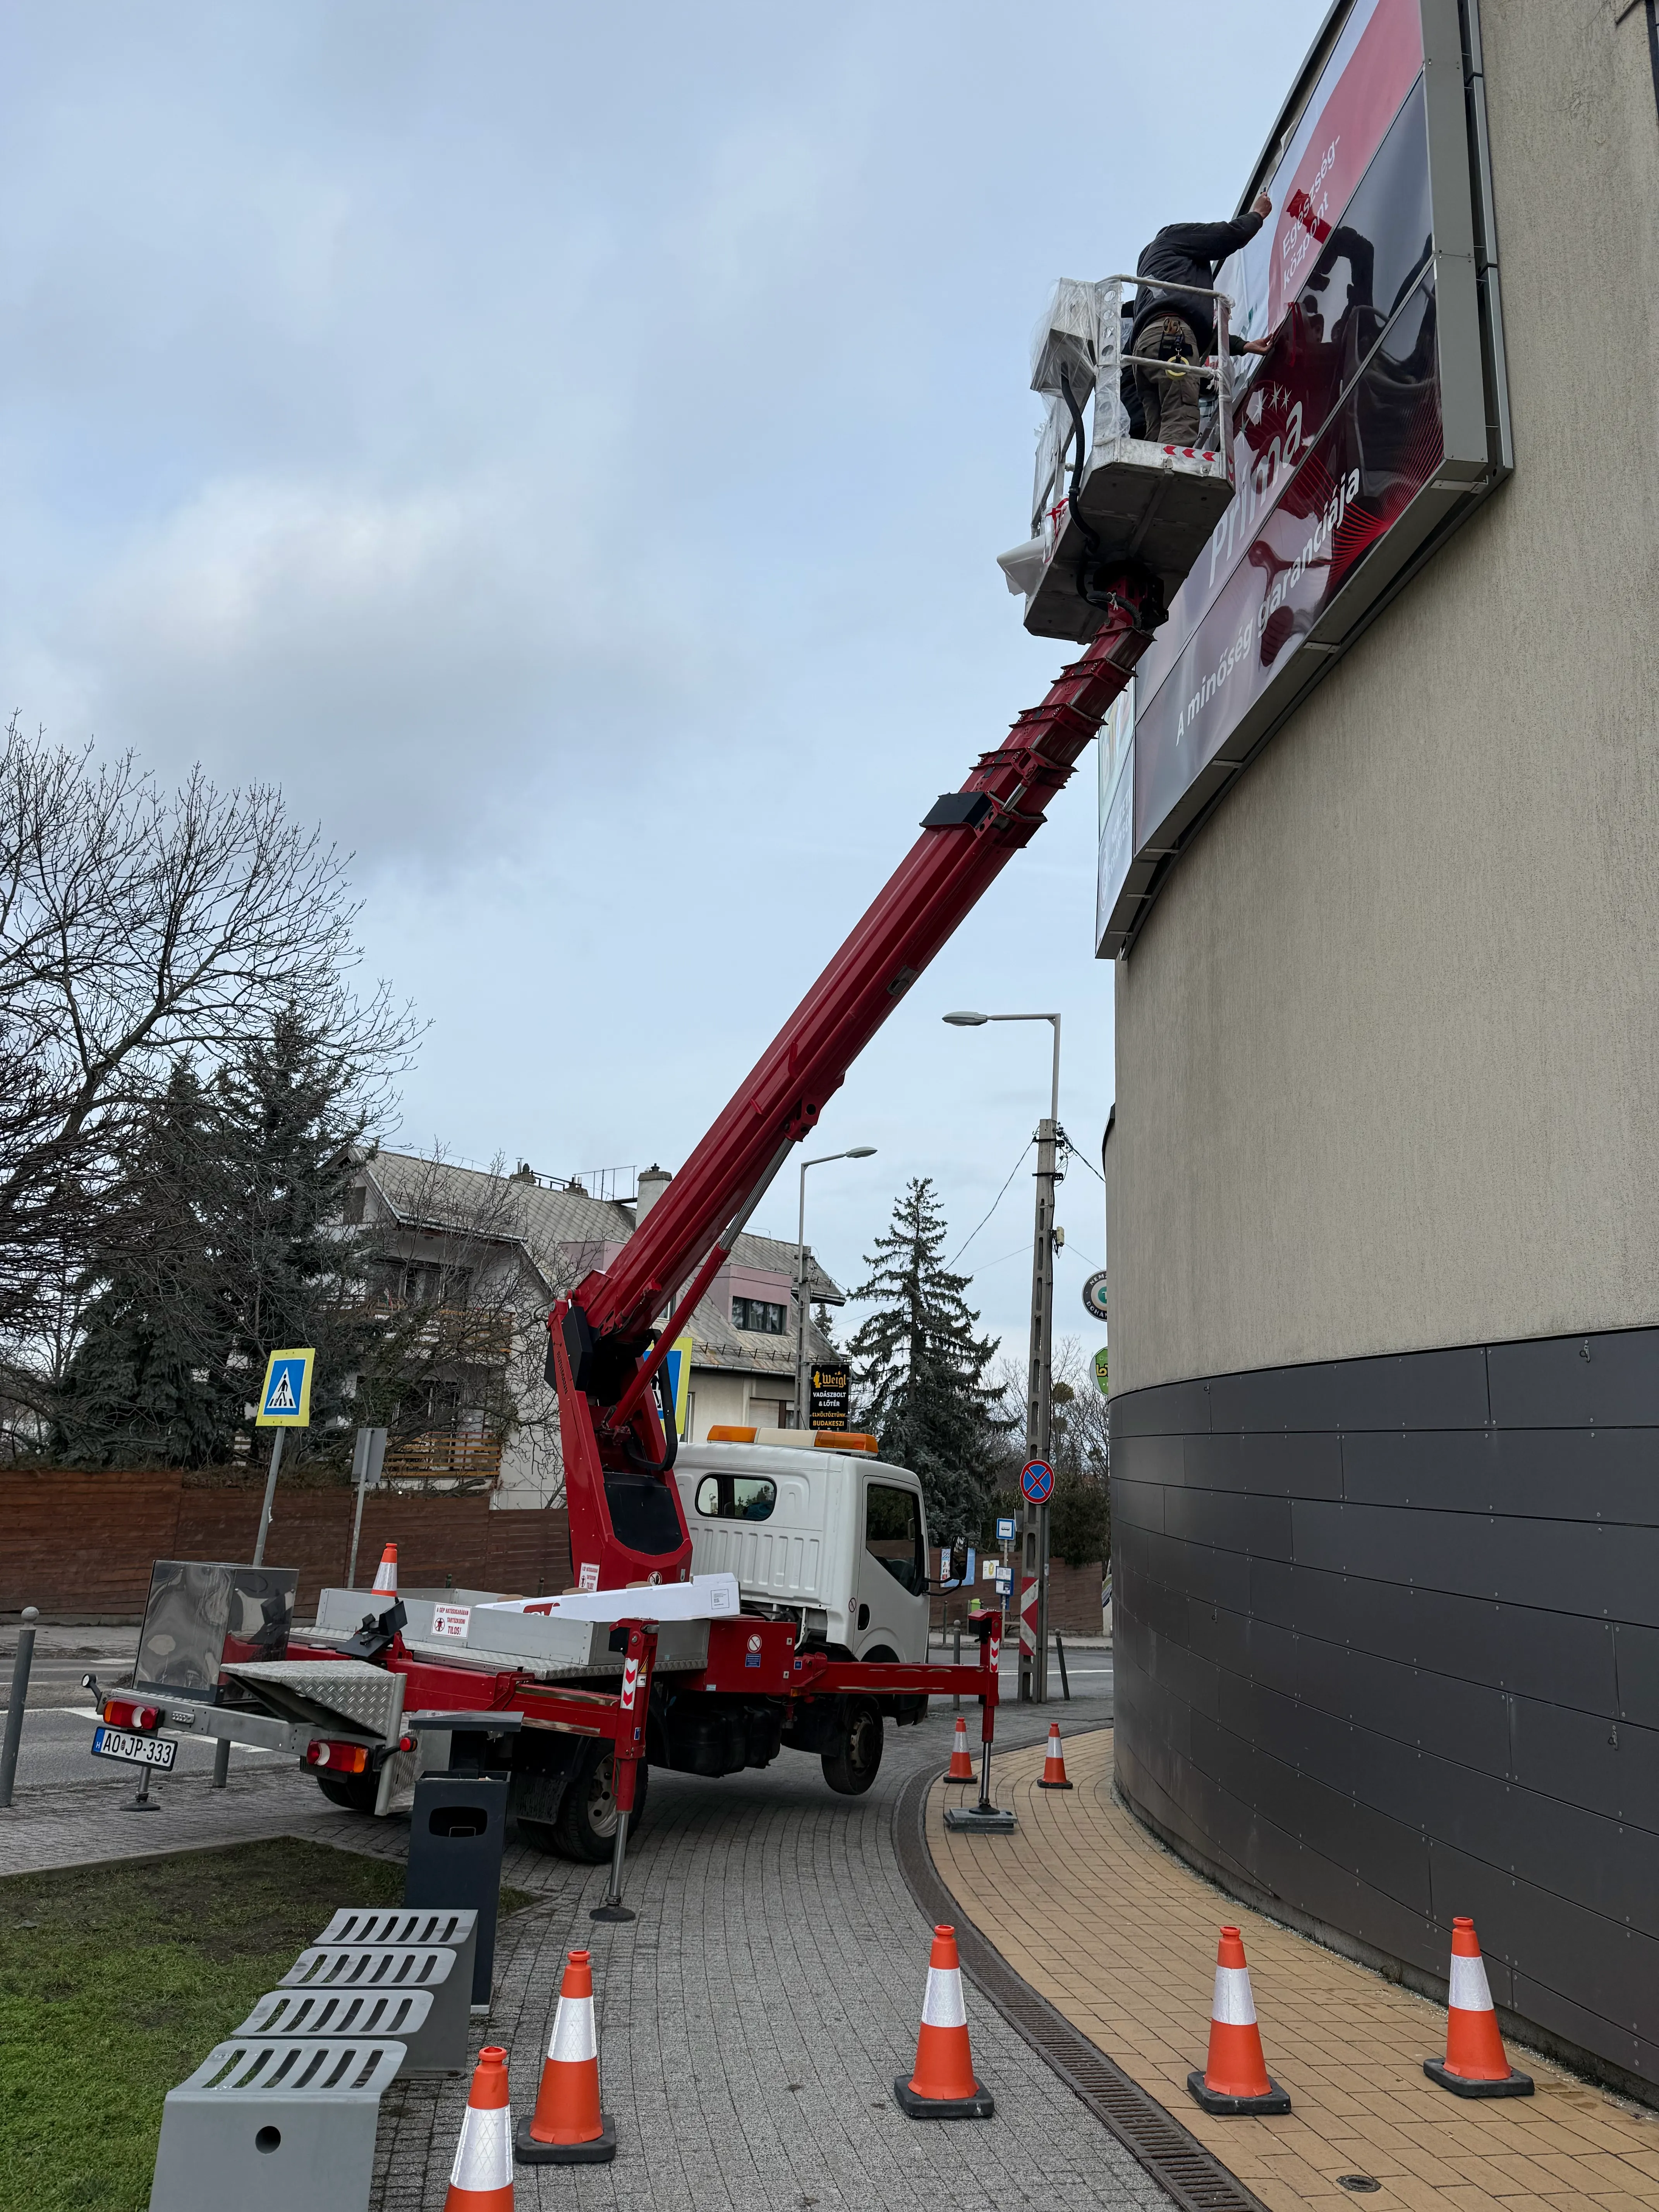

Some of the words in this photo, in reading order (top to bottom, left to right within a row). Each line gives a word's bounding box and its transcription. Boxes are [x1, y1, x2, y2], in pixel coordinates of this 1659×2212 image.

[1283, 135, 1340, 259] Egészség-
[1284, 190, 1329, 290] központ
[1176, 710, 1184, 747] A
[1187, 617, 1254, 726] minőség
[1257, 467, 1360, 639] garanciája
[823, 1372, 846, 1388] Weigl
[448, 1626, 461, 1635] TILOS!
[103, 1733, 120, 1753] AO
